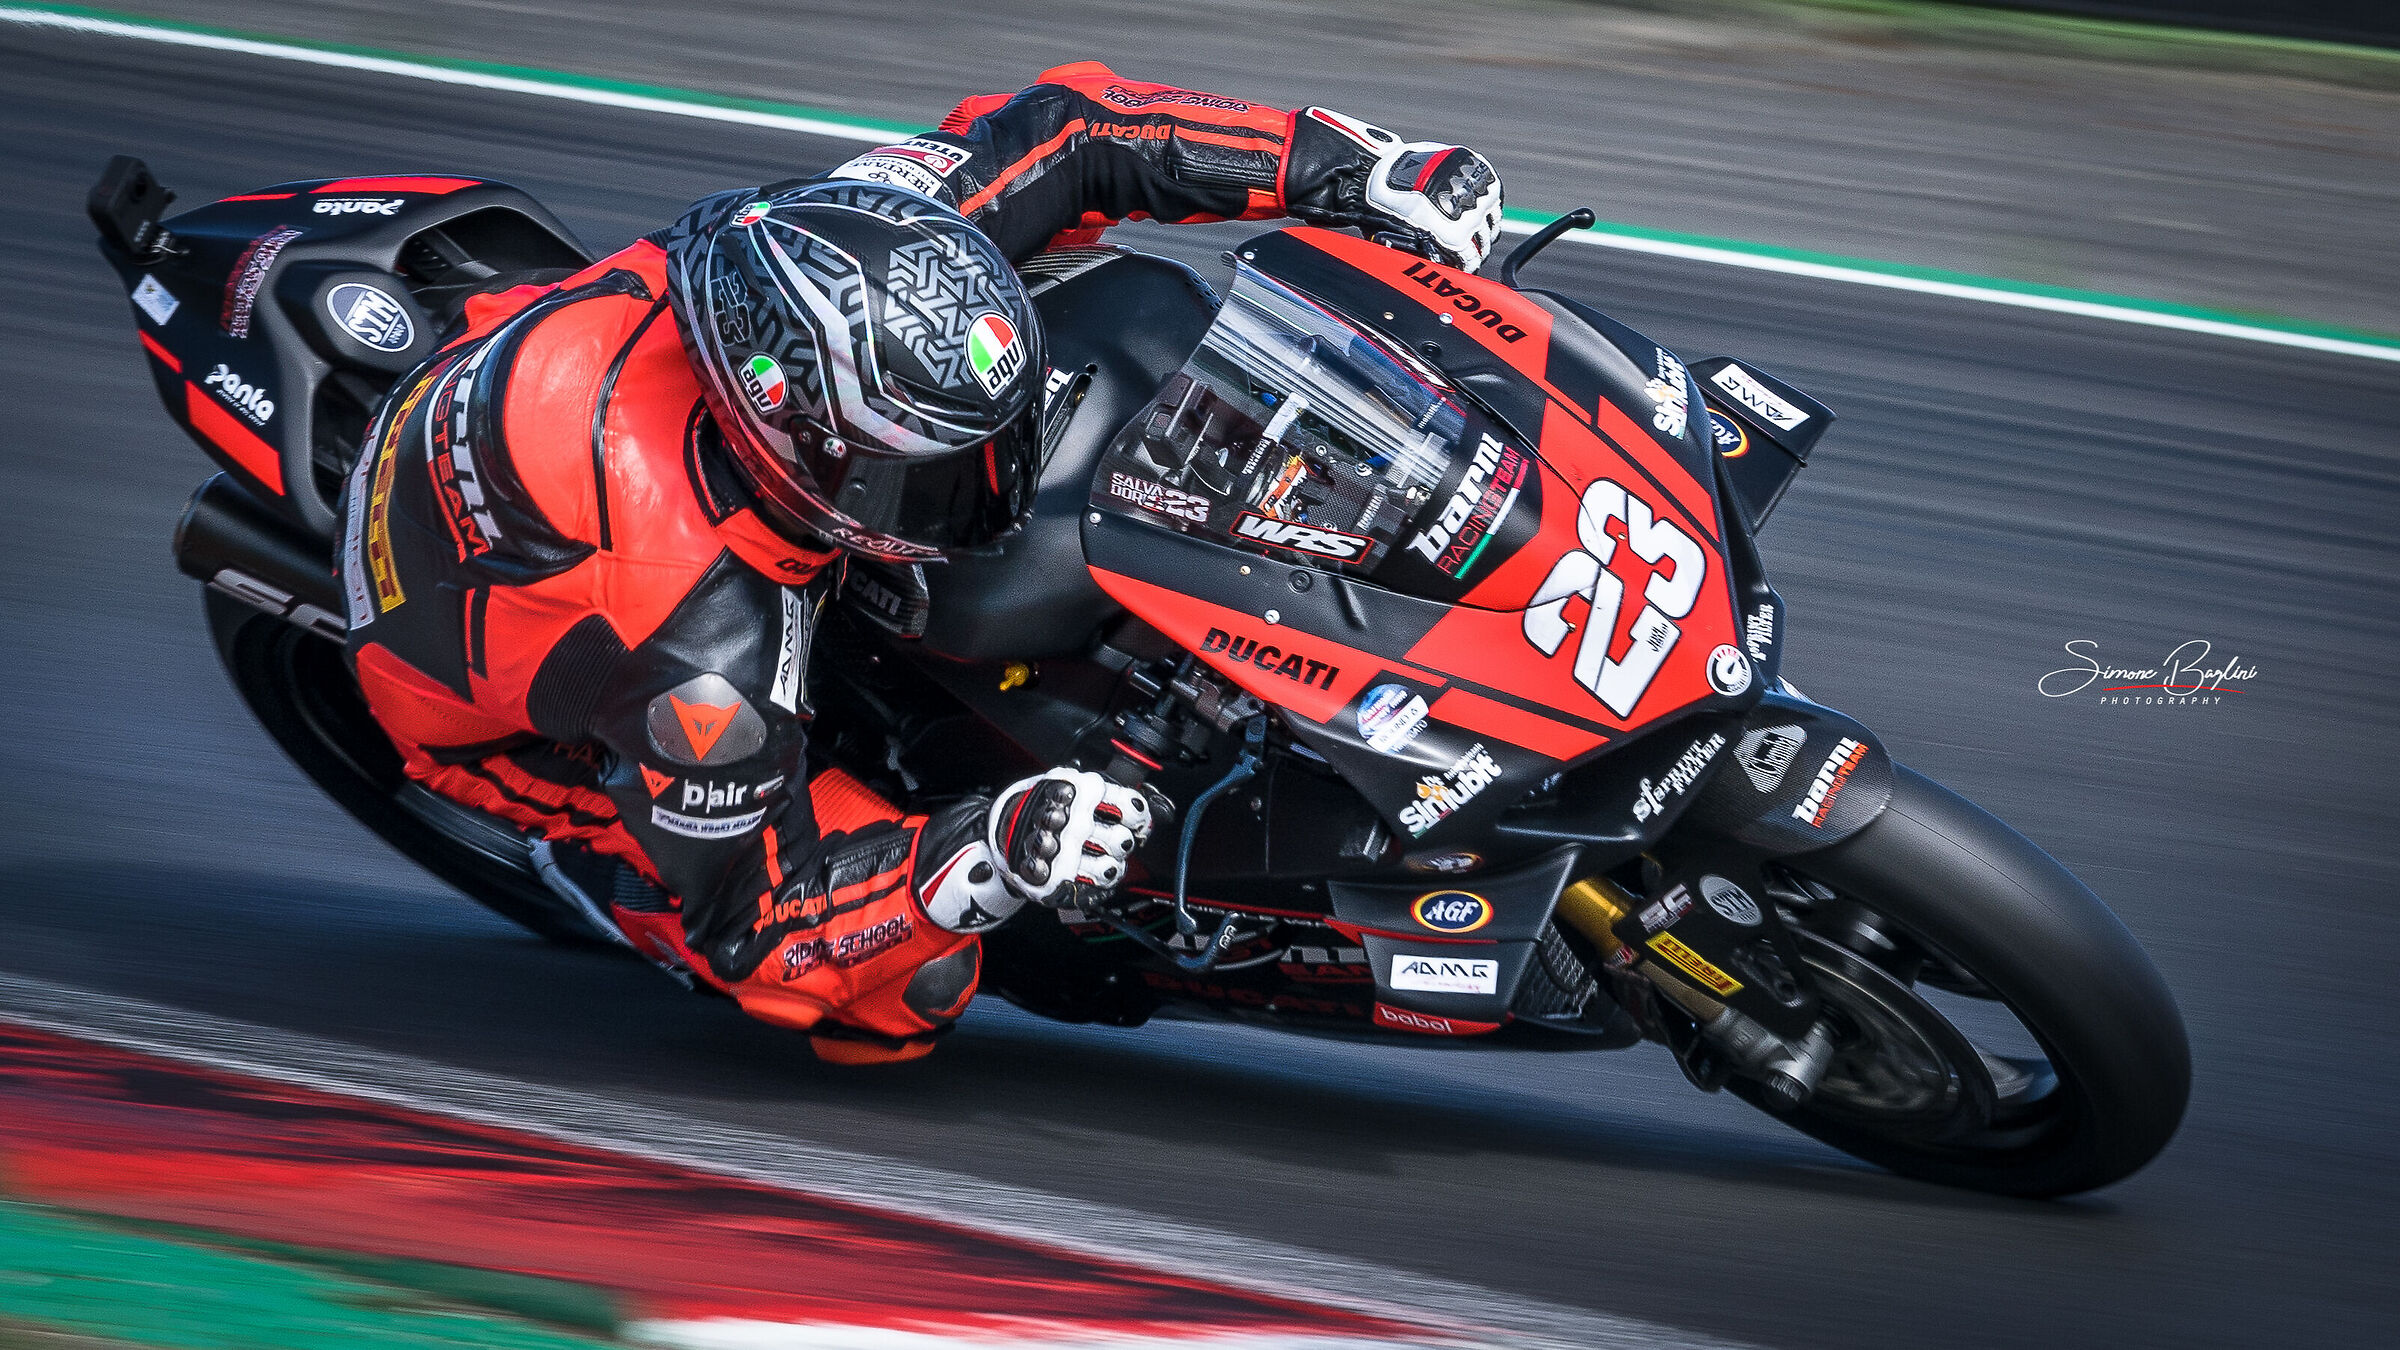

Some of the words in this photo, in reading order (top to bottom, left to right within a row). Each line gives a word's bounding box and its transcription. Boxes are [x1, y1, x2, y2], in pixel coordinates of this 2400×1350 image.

[1090, 123, 1171, 139] DUCATI
[348, 289, 400, 342] STM
[1402, 261, 1528, 344] DUCATI
[1111, 472, 1165, 497] SALVA
[1165, 488, 1210, 522] 23
[1235, 515, 1367, 557] WRS
[1522, 476, 1707, 721] 23
[1200, 627, 1340, 691] DUCATI
[762, 894, 827, 927] DUCATI
[1424, 900, 1479, 922] AGF
[837, 913, 912, 960] SCHOOL
[1380, 1008, 1453, 1034] babol
